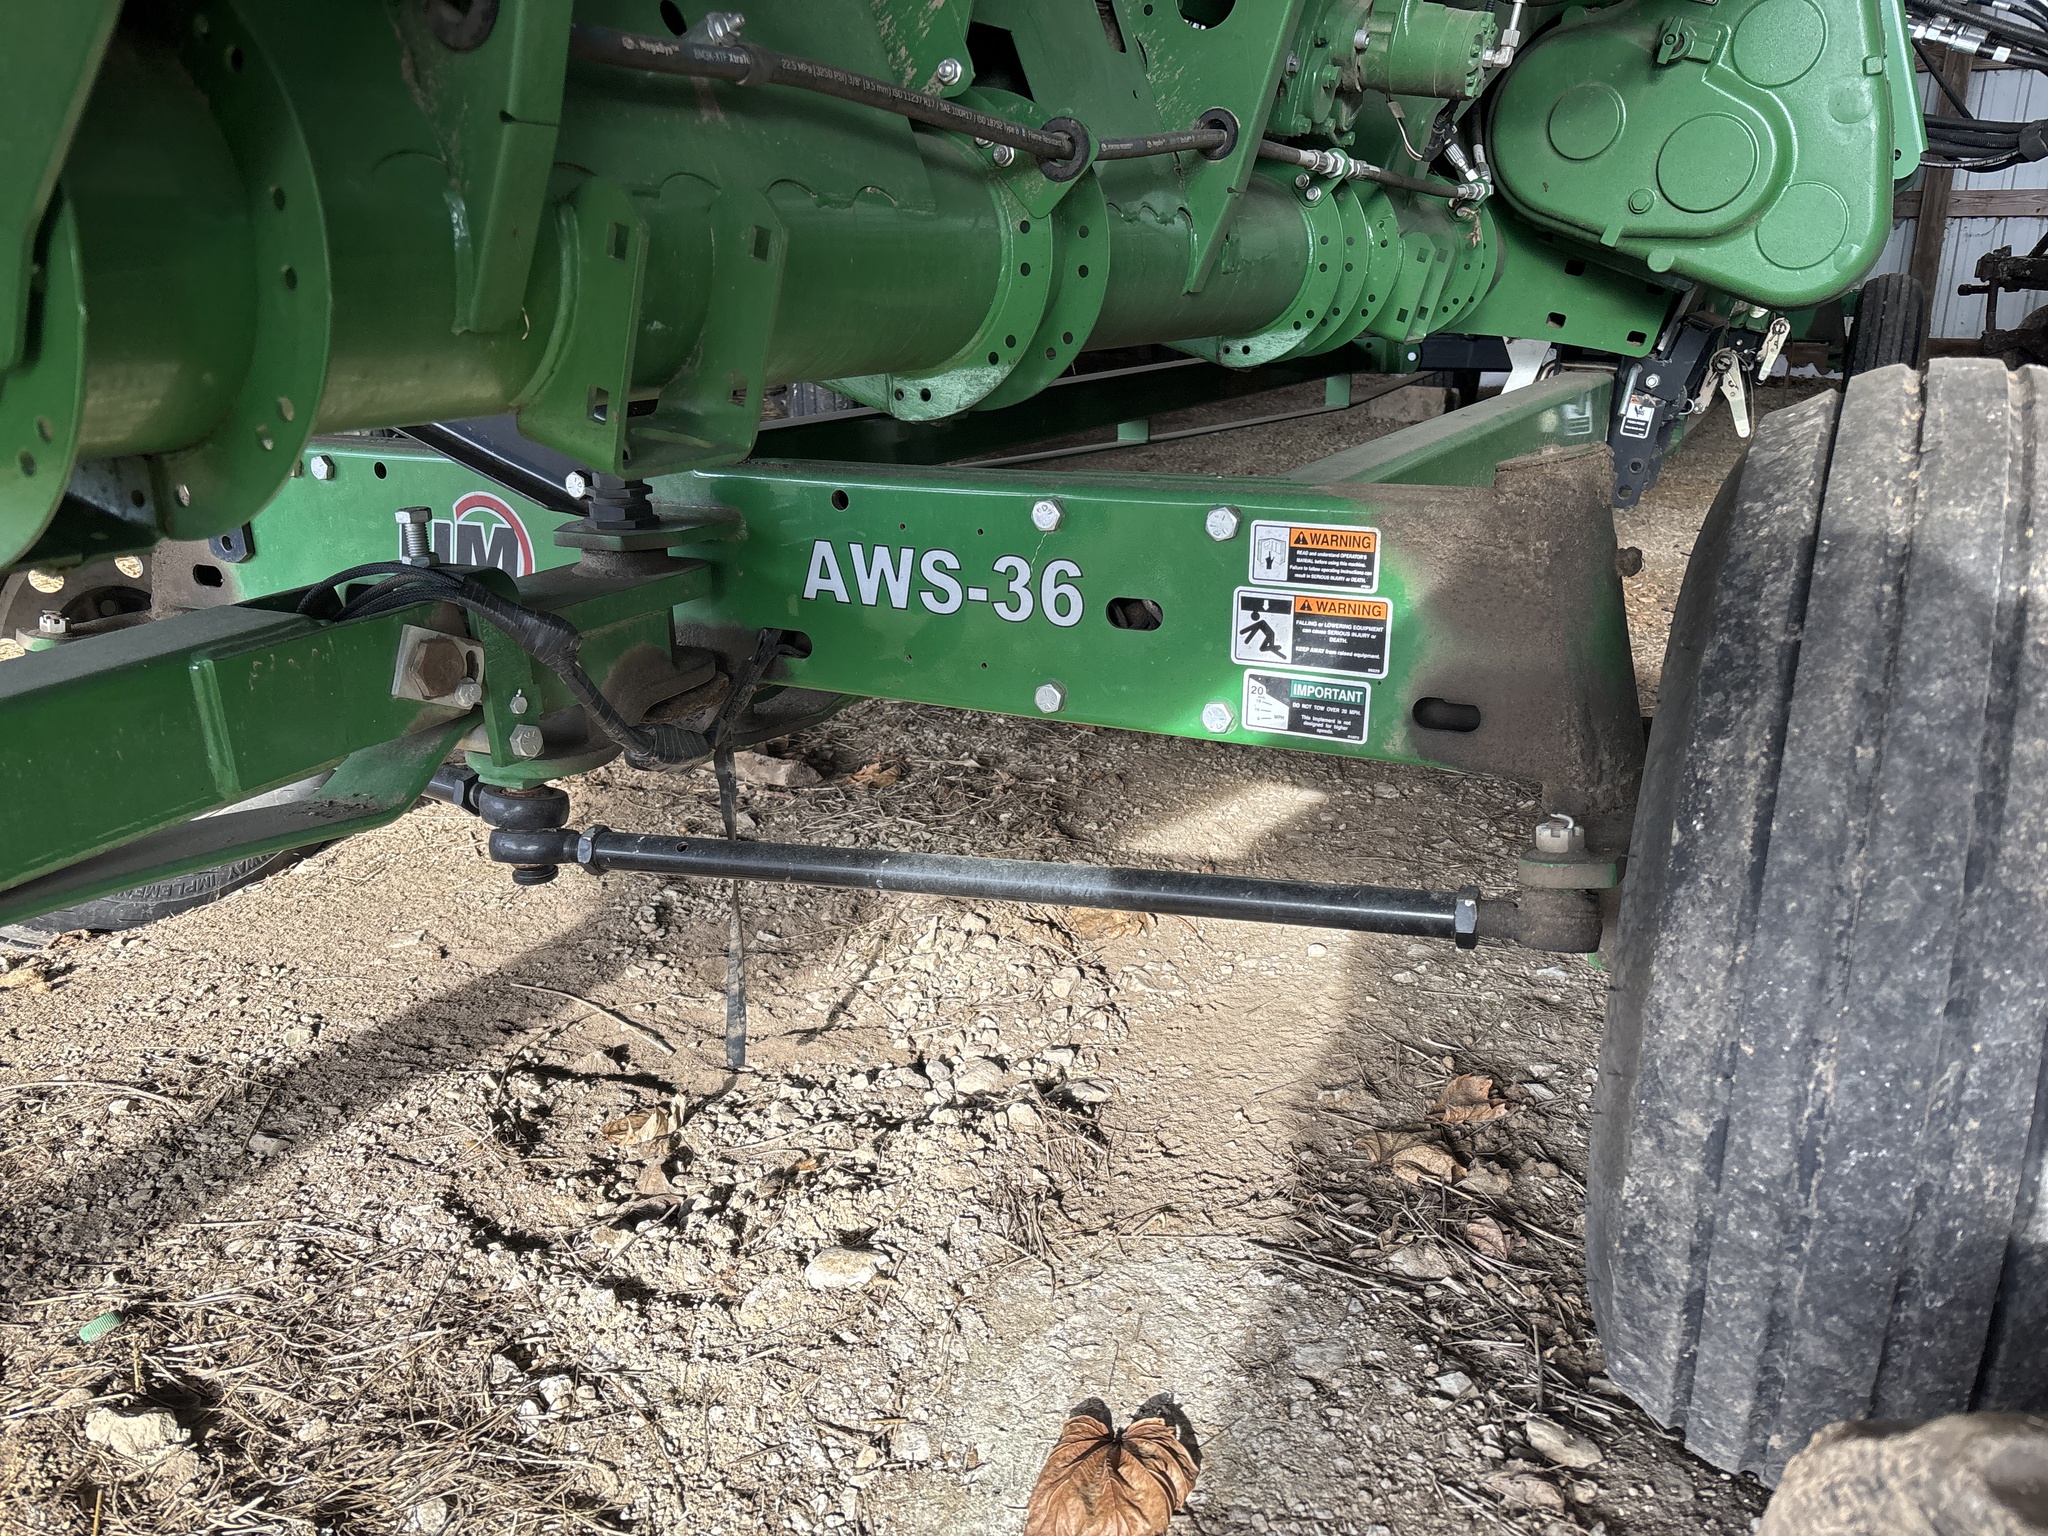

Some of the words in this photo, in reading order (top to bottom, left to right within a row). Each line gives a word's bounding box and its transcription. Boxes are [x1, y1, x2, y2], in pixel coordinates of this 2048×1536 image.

[798, 63, 812, 74] MPa
[813, 65, 832, 78] (3250
[834, 71, 847, 84] PSI)
[876, 85, 891, 97] mm)
[892, 89, 902, 98] ISO
[904, 92, 922, 104] 11237
[923, 97, 934, 107] R17
[940, 103, 951, 113] SAE
[952, 107, 972, 120] 100R17
[977, 116, 986, 125] ISO
[1004, 123, 1015, 133] Type
[1310, 533, 1371, 549] WARNING
[801, 538, 1085, 628] AWS-36
[1316, 600, 1382, 616] WARNING
[1324, 622, 1352, 630] LOWERING
[1353, 625, 1384, 633] EQUIPMENT
[1251, 686, 1264, 695] 20
[1293, 683, 1363, 703] IMPORTANT
